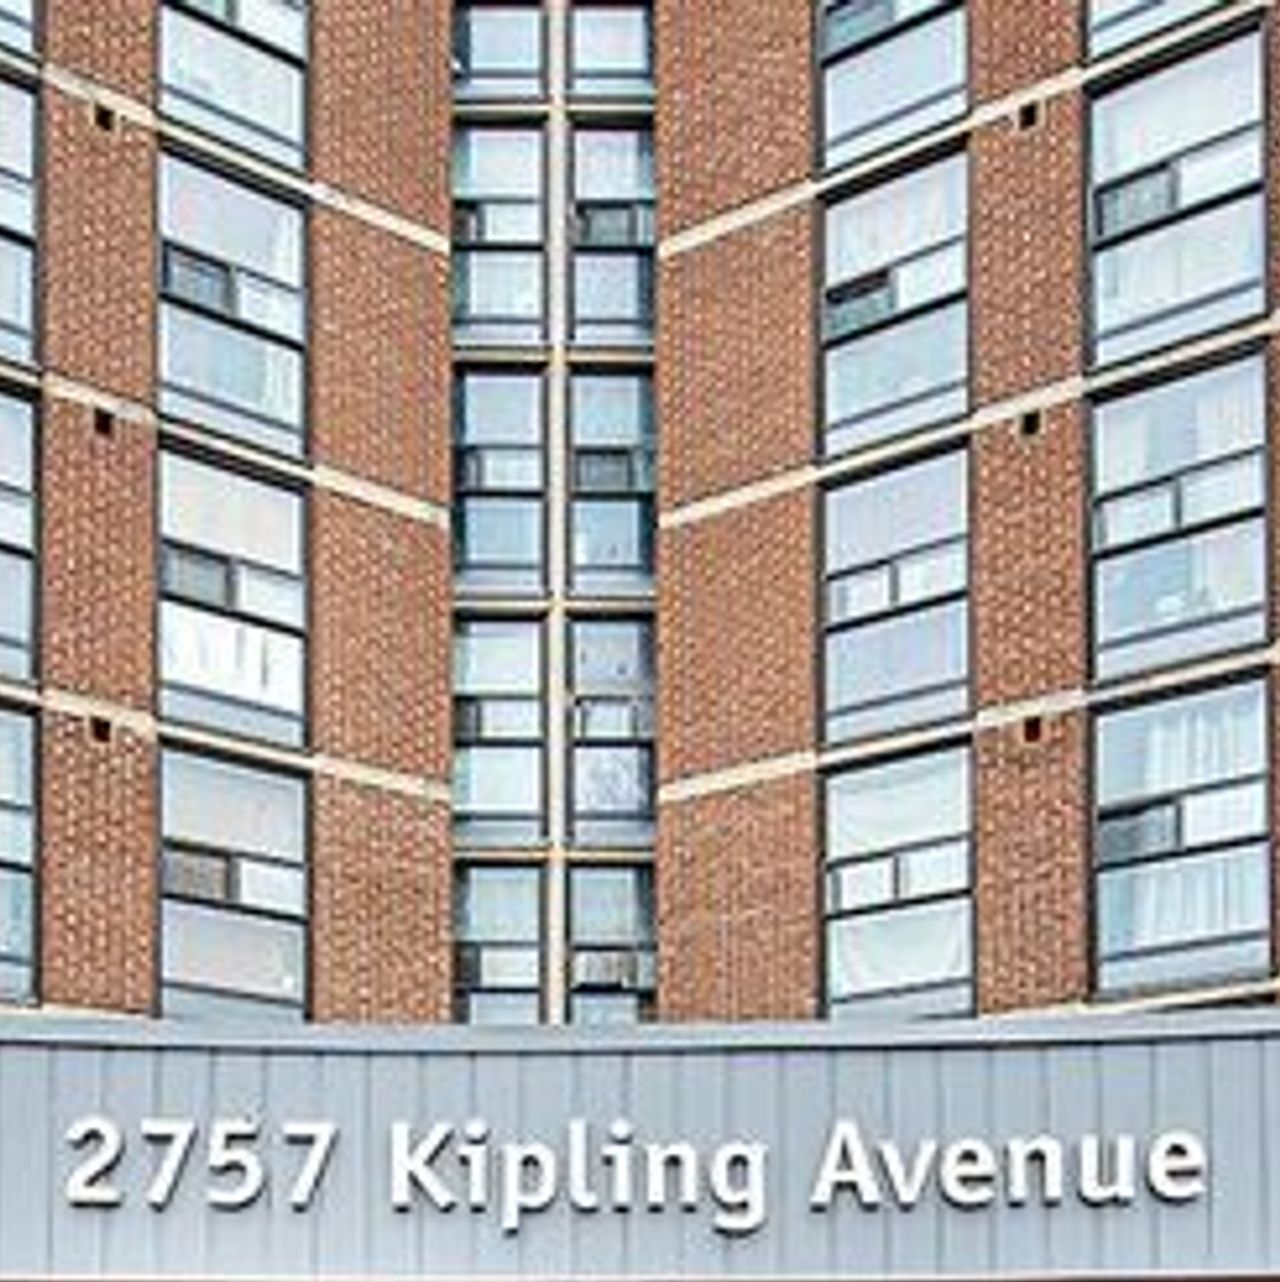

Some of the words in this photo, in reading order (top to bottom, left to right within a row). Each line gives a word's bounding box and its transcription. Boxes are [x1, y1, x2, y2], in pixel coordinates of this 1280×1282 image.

[65, 1116, 340, 1211] 2757
[389, 1118, 770, 1235] Kipling
[810, 1118, 1209, 1212] Avenue
